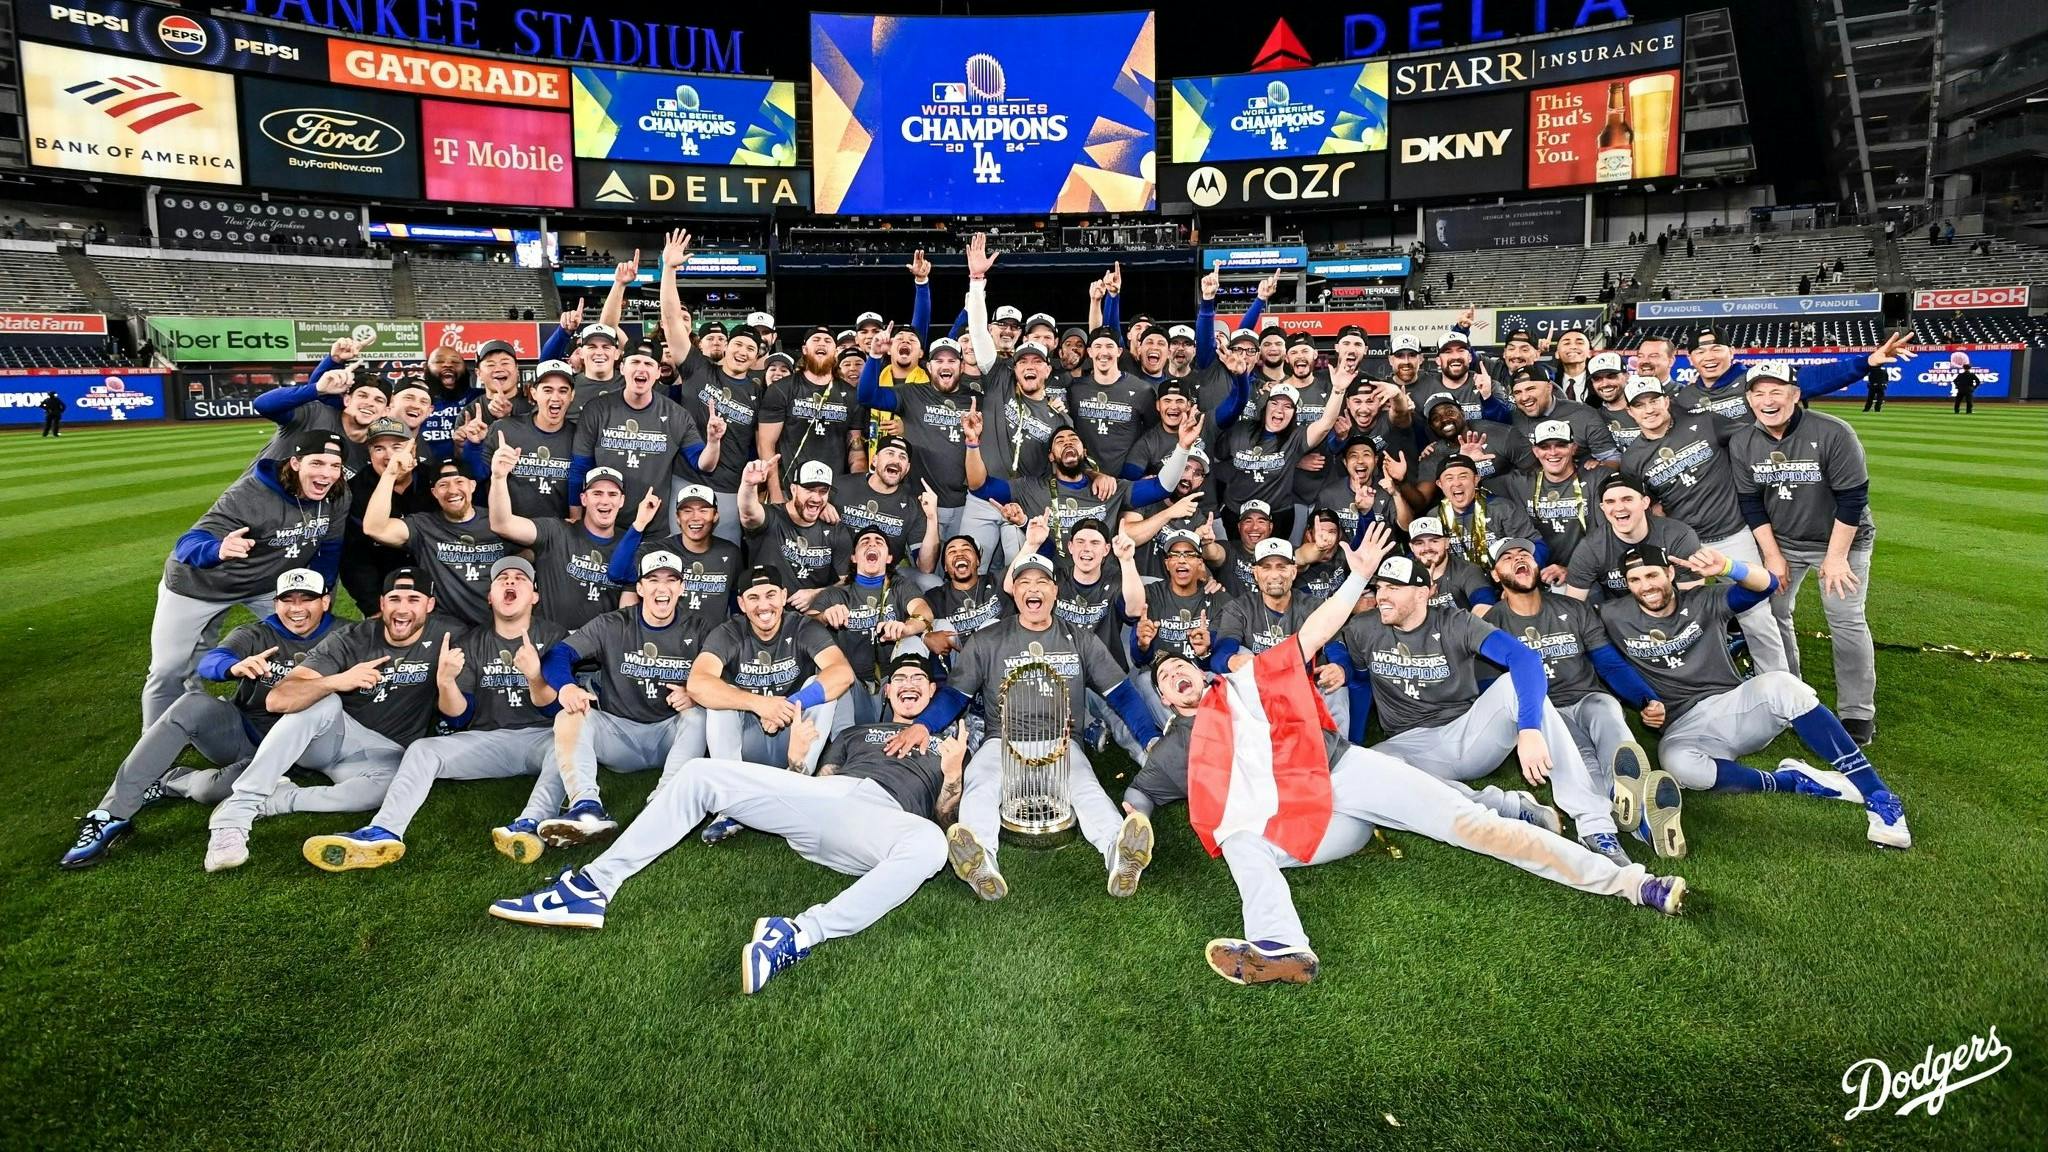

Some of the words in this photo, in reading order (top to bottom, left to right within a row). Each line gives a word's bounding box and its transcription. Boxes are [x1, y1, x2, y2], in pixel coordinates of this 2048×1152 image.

[49, 4, 129, 33] PEPSI
[161, 27, 206, 43] PEPSI
[513, 9, 745, 74] STADIUM
[234, 37, 299, 61] PEPSI
[1396, 52, 1527, 95] STARR
[1539, 35, 1676, 70] INSURANCE
[345, 50, 560, 100] GATORADE
[922, 104, 982, 116] WORLD
[987, 104, 1048, 115] SERIES
[1242, 108, 1277, 116] WORLD
[1279, 104, 1314, 114] SERIES
[1536, 94, 1583, 111] This
[651, 111, 686, 119] WORLD
[1231, 111, 1326, 131] CHAMPIONS
[1536, 109, 1593, 129] Bud's
[287, 113, 379, 154] Ford
[639, 116, 736, 136] CHAMPIONS
[902, 115, 1068, 142] CHAMPIONS
[681, 133, 700, 155] LA
[1271, 128, 1287, 150] LA
[1401, 129, 1513, 164] DKNY
[1536, 132, 1570, 147] For
[35, 136, 100, 157] BANK
[107, 145, 135, 160] OF
[140, 149, 236, 170] AMERICA
[945, 143, 964, 152] 20
[1006, 143, 1025, 152] 24
[468, 139, 564, 173] Mobile
[973, 143, 1001, 183] LA
[1535, 149, 1580, 165] You.
[288, 157, 384, 174] BuyFordNow.com
[650, 174, 798, 204] DELTA
[1243, 162, 1355, 202] razr
[223, 215, 244, 226] New
[244, 217, 268, 230] York
[269, 218, 306, 231] Yankees
[1494, 237, 1516, 246] THE
[1520, 234, 1549, 244] BOSS
[1365, 287, 1399, 296] TERRACE
[1736, 302, 1778, 311] FANDUEL
[1815, 299, 1861, 308] FANDUEL
[1917, 290, 2026, 309] Reebok
[1663, 305, 1703, 313] FANDUEL
[41, 317, 84, 332] Farm
[299, 322, 350, 333] Morningside
[376, 323, 418, 331] Workman's
[1283, 321, 1322, 329] TOYOTA
[1537, 320, 1594, 331] CLEAR
[227, 331, 288, 349] Eats
[396, 332, 418, 341] Circle
[76, 397, 154, 407] CHAMPIONS
[195, 402, 261, 417] StubH
[795, 399, 820, 411] WORLD
[822, 404, 848, 412] SERIES
[1079, 401, 1105, 411] WORLD
[1105, 403, 1132, 413] SERIES
[1711, 399, 1744, 412] SERIES
[727, 402, 754, 418] SERIES
[926, 406, 957, 416] WORLD
[1078, 409, 1132, 420] CHAMPIONS
[441, 416, 453, 431] LA
[815, 421, 825, 436] LA
[1098, 419, 1108, 435] LA
[602, 429, 635, 440] WORLD
[637, 431, 667, 442] SERIES
[949, 426, 960, 442] LA
[601, 437, 667, 451] CHAMPIONS
[627, 451, 639, 468] LA
[1236, 452, 1259, 462] WORLD
[1260, 451, 1285, 460] SERIES
[1646, 458, 1677, 478] WORLD
[1675, 440, 1709, 460] SERIES
[1650, 447, 1714, 487] CHAMPIONS
[1751, 463, 1783, 473] WORLD
[1783, 462, 1819, 471] SERIES
[1253, 470, 1264, 483] LA
[1679, 473, 1697, 487] LA
[1753, 470, 1821, 483] CHAMPIONS
[539, 477, 551, 494] LA
[1778, 484, 1792, 500] LA
[844, 507, 876, 520] WORLD
[875, 513, 904, 527] SERIES
[1077, 505, 1106, 517] SERIES
[1552, 519, 1564, 533] LA
[437, 543, 475, 553] WORLD
[475, 543, 504, 552] SERIES
[806, 548, 832, 557] SERIES
[466, 563, 479, 581] LA
[701, 574, 727, 583] SERIES
[797, 566, 809, 579] LA
[588, 582, 600, 601] LA
[689, 592, 701, 610] LA
[1056, 601, 1085, 614] WORLD
[946, 611, 977, 622] WORLD
[1160, 620, 1188, 629] WORLD
[1542, 634, 1576, 648] SERIES
[1625, 639, 1663, 650] WORLD
[1183, 640, 1194, 658] LA
[656, 658, 692, 669] SERIES
[771, 659, 796, 674] SERIES
[1044, 654, 1079, 664] SERIES
[1373, 652, 1411, 666] WORLD
[1411, 655, 1447, 666] SERIES
[1663, 654, 1685, 669] LA
[397, 662, 431, 673] ERIES
[1372, 661, 1450, 678] CHAMPIONS
[735, 667, 800, 686] CHAMPIONS
[645, 679, 657, 698] LA
[1404, 679, 1420, 699] LA
